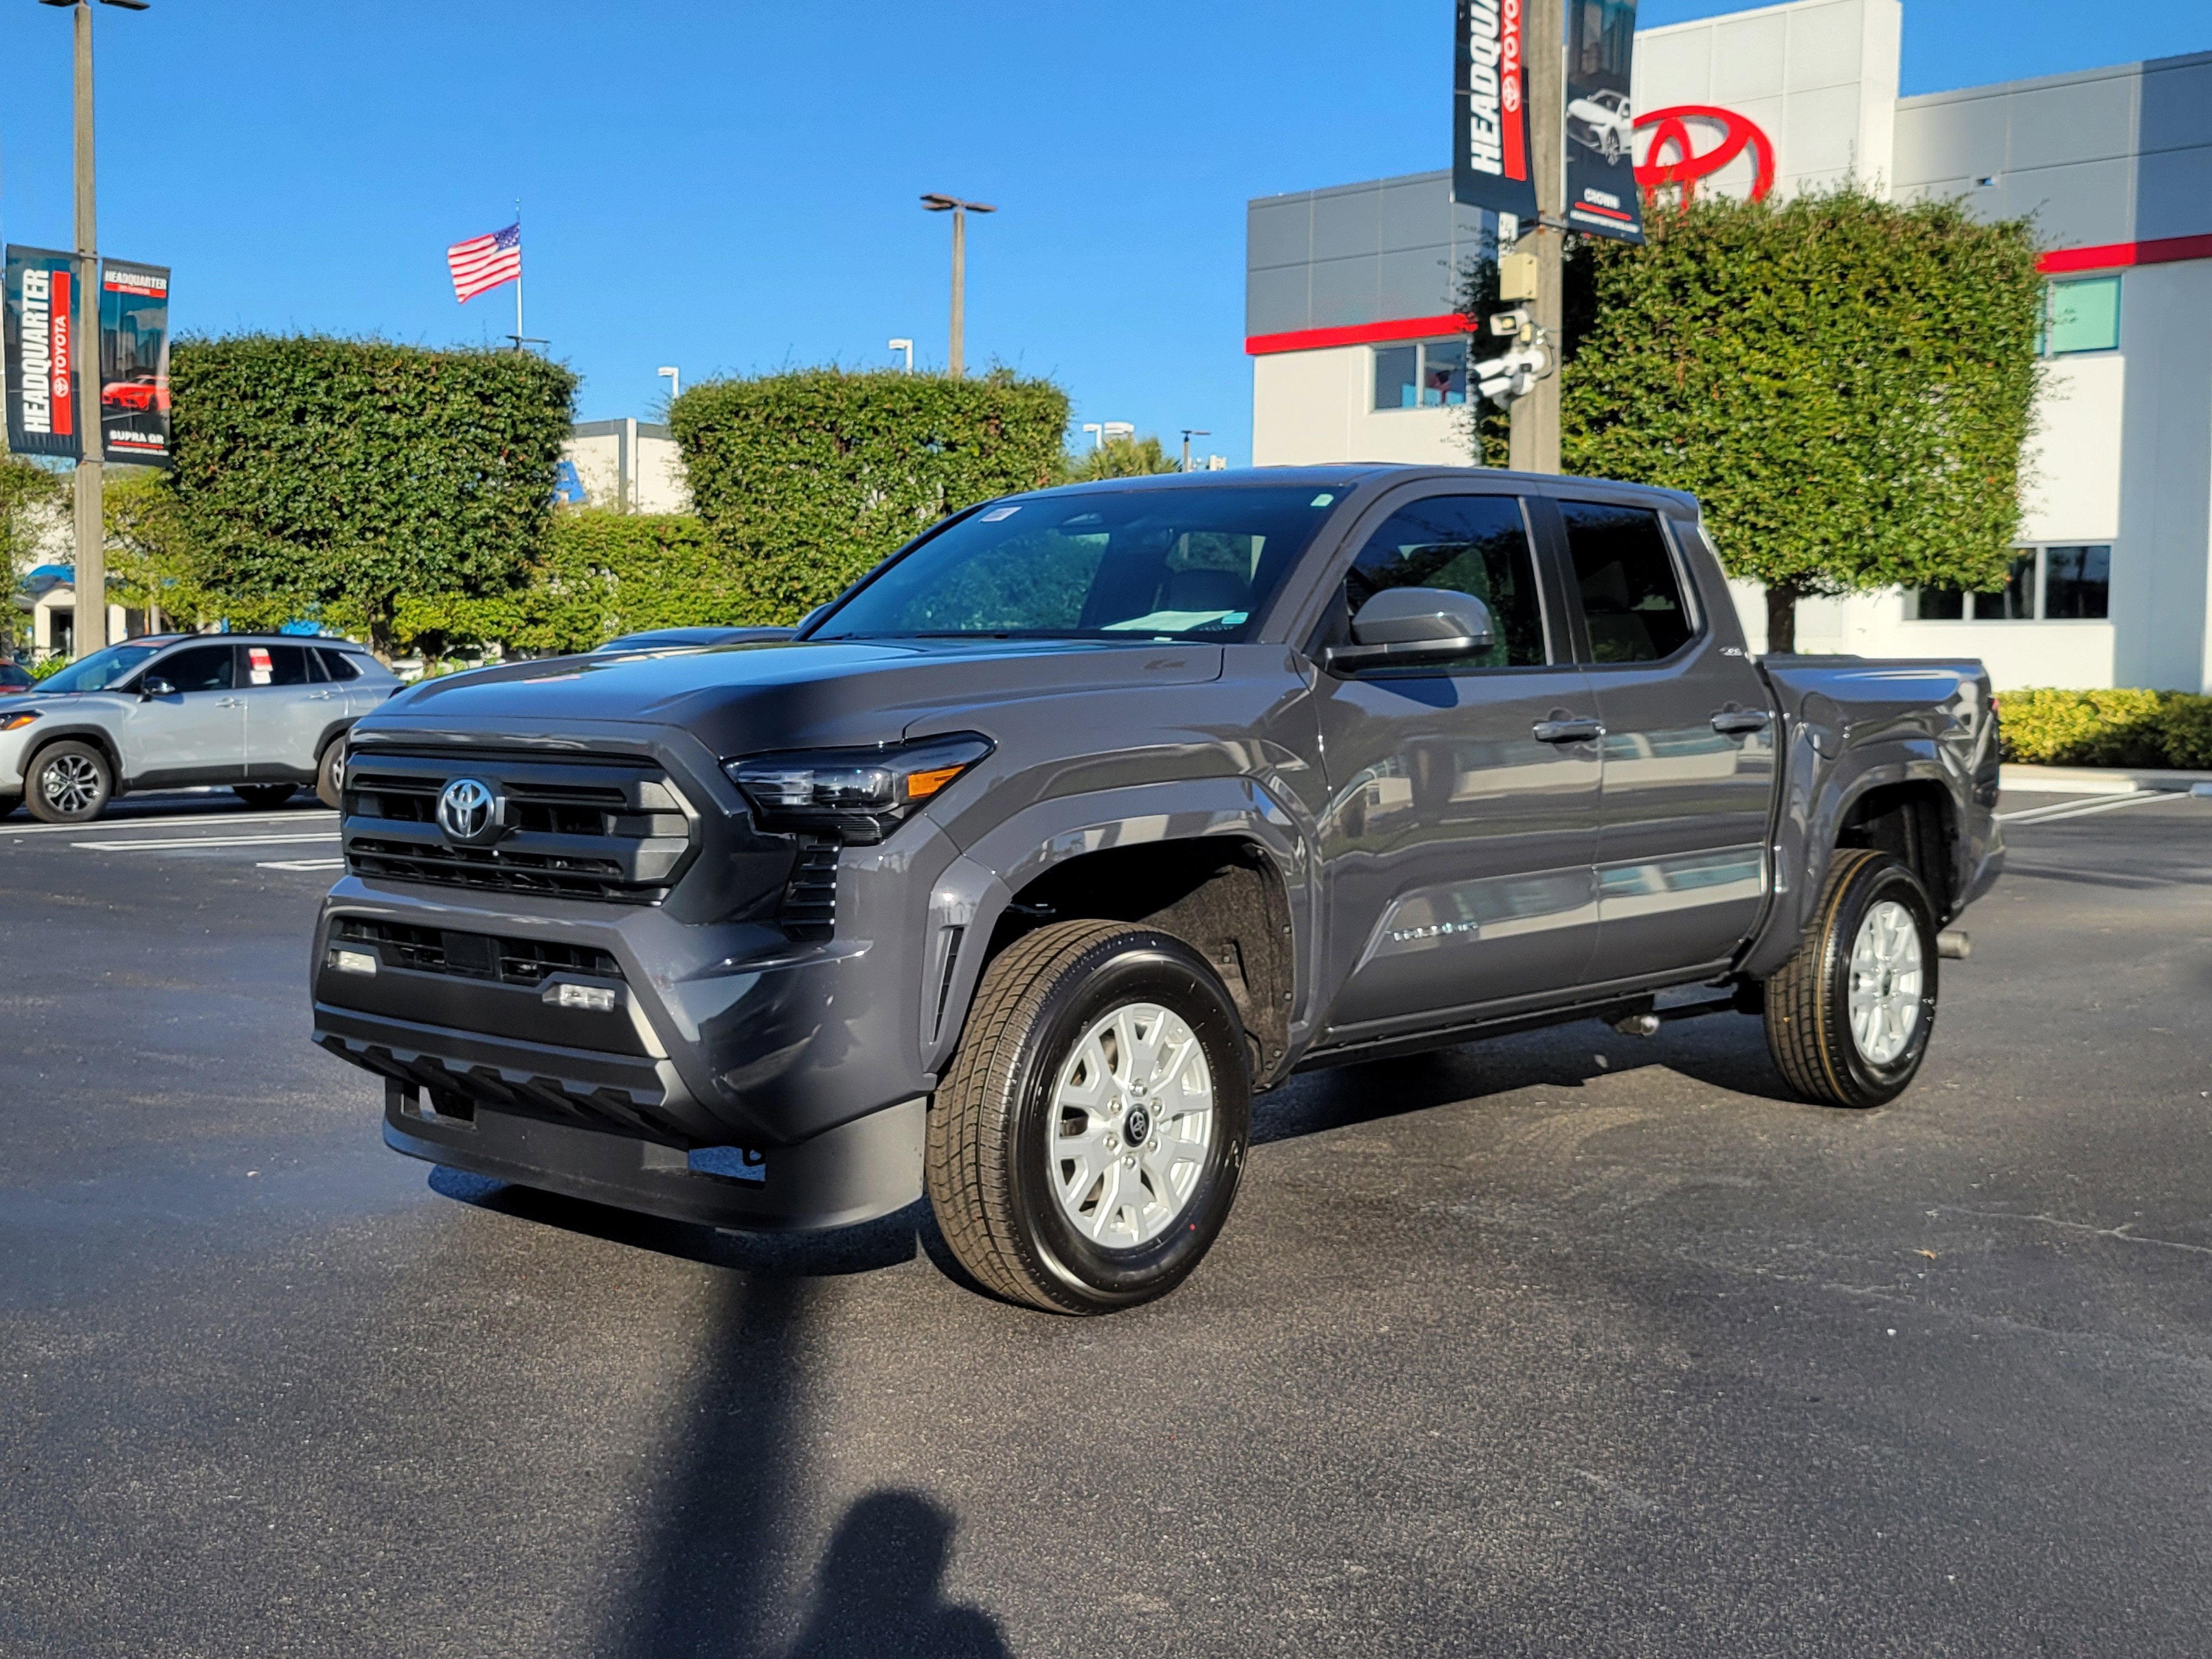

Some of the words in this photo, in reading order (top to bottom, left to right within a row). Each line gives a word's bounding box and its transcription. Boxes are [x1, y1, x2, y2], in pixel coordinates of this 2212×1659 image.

[104, 270, 167, 290] HEADQUARTER
[22, 268, 52, 433] HEADQUARTER
[54, 314, 67, 375] TOYOTA
[109, 430, 147, 443] SUPRA
[148, 433, 165, 444] GR
